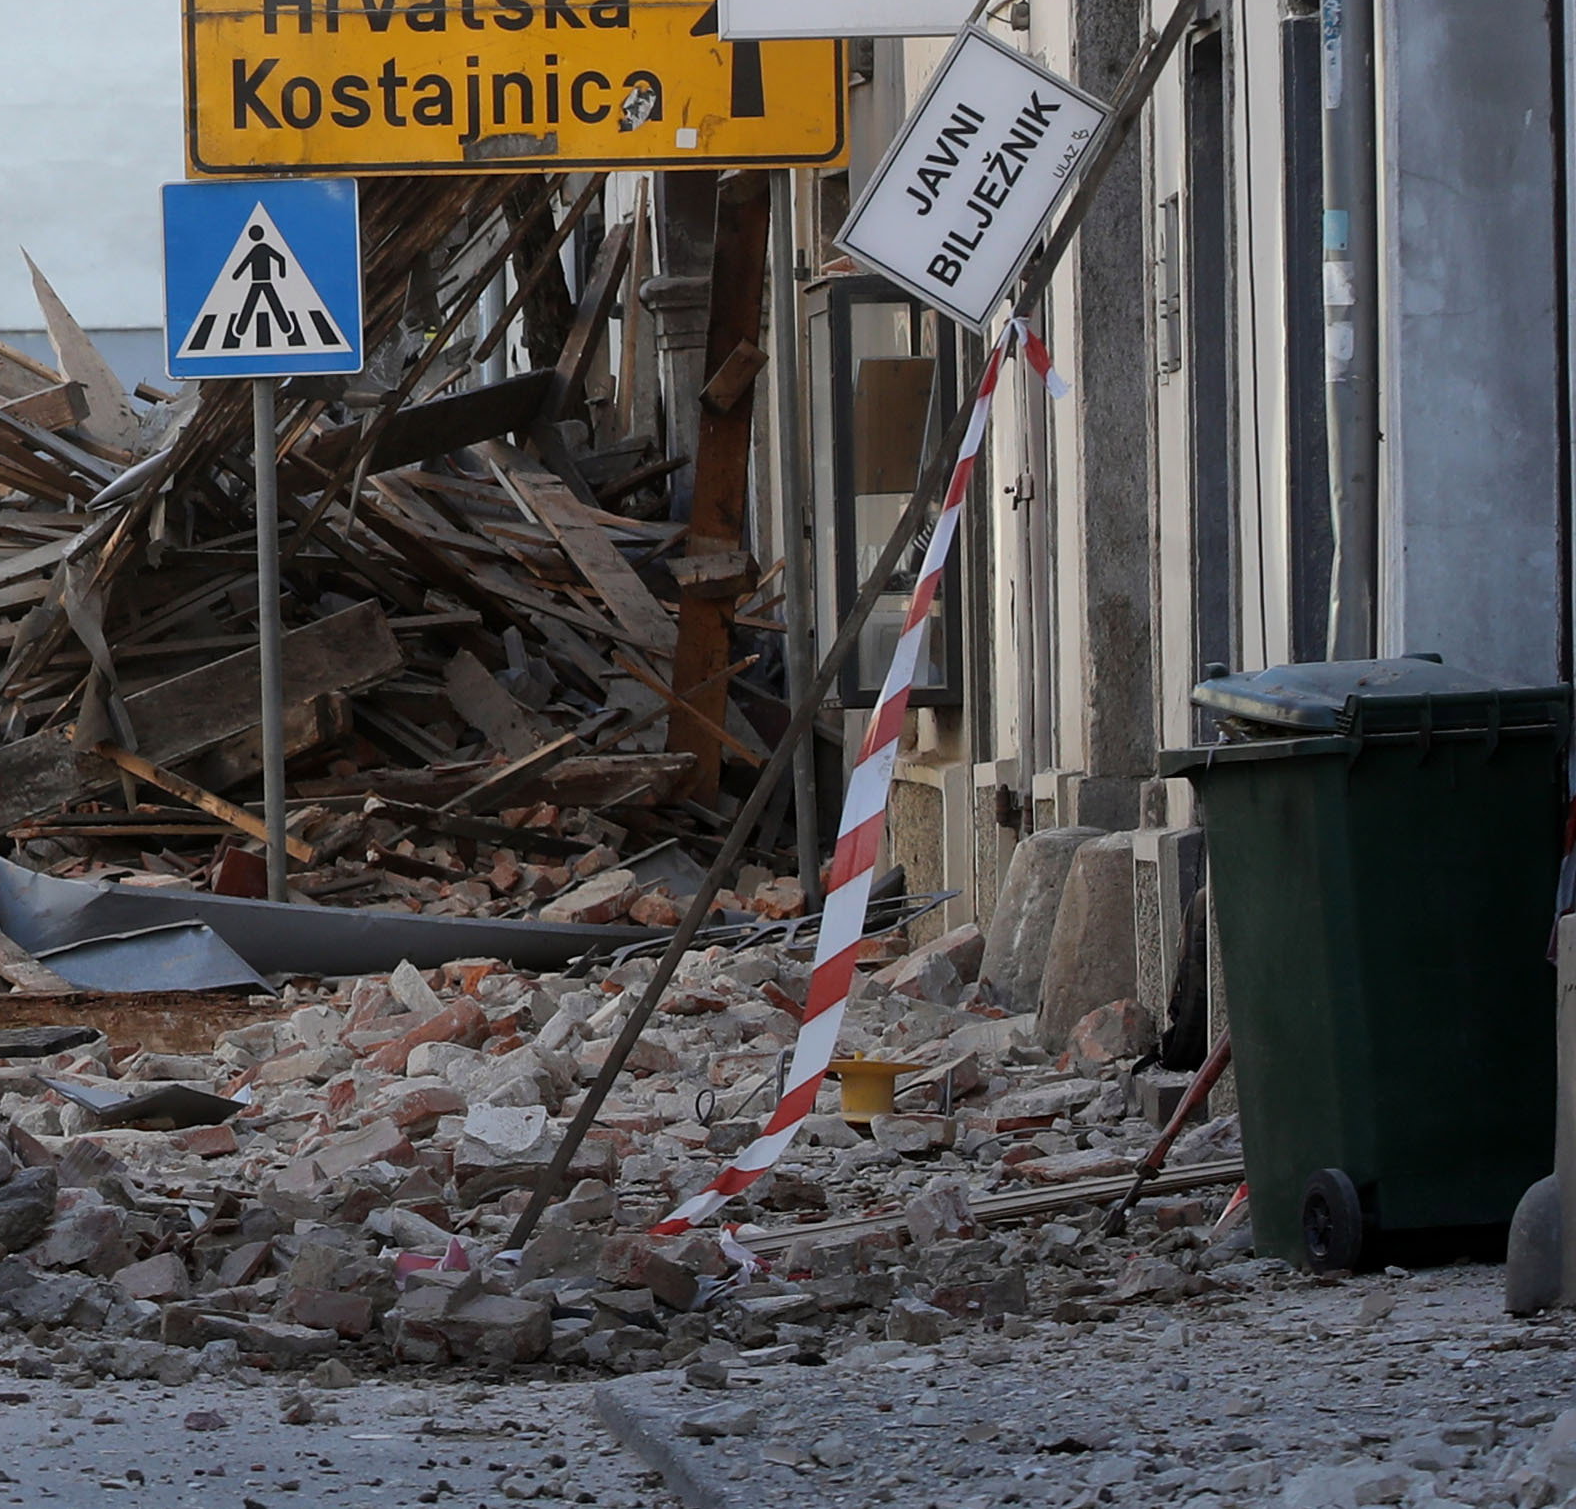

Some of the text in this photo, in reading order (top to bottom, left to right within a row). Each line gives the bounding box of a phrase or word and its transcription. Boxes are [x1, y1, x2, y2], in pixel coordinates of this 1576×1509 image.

[231, 53, 665, 146] Kostajnica
[904, 102, 987, 217] JAVNI
[925, 89, 1062, 288] BILJEŽNIK
[1051, 144, 1080, 180] ULAZ
